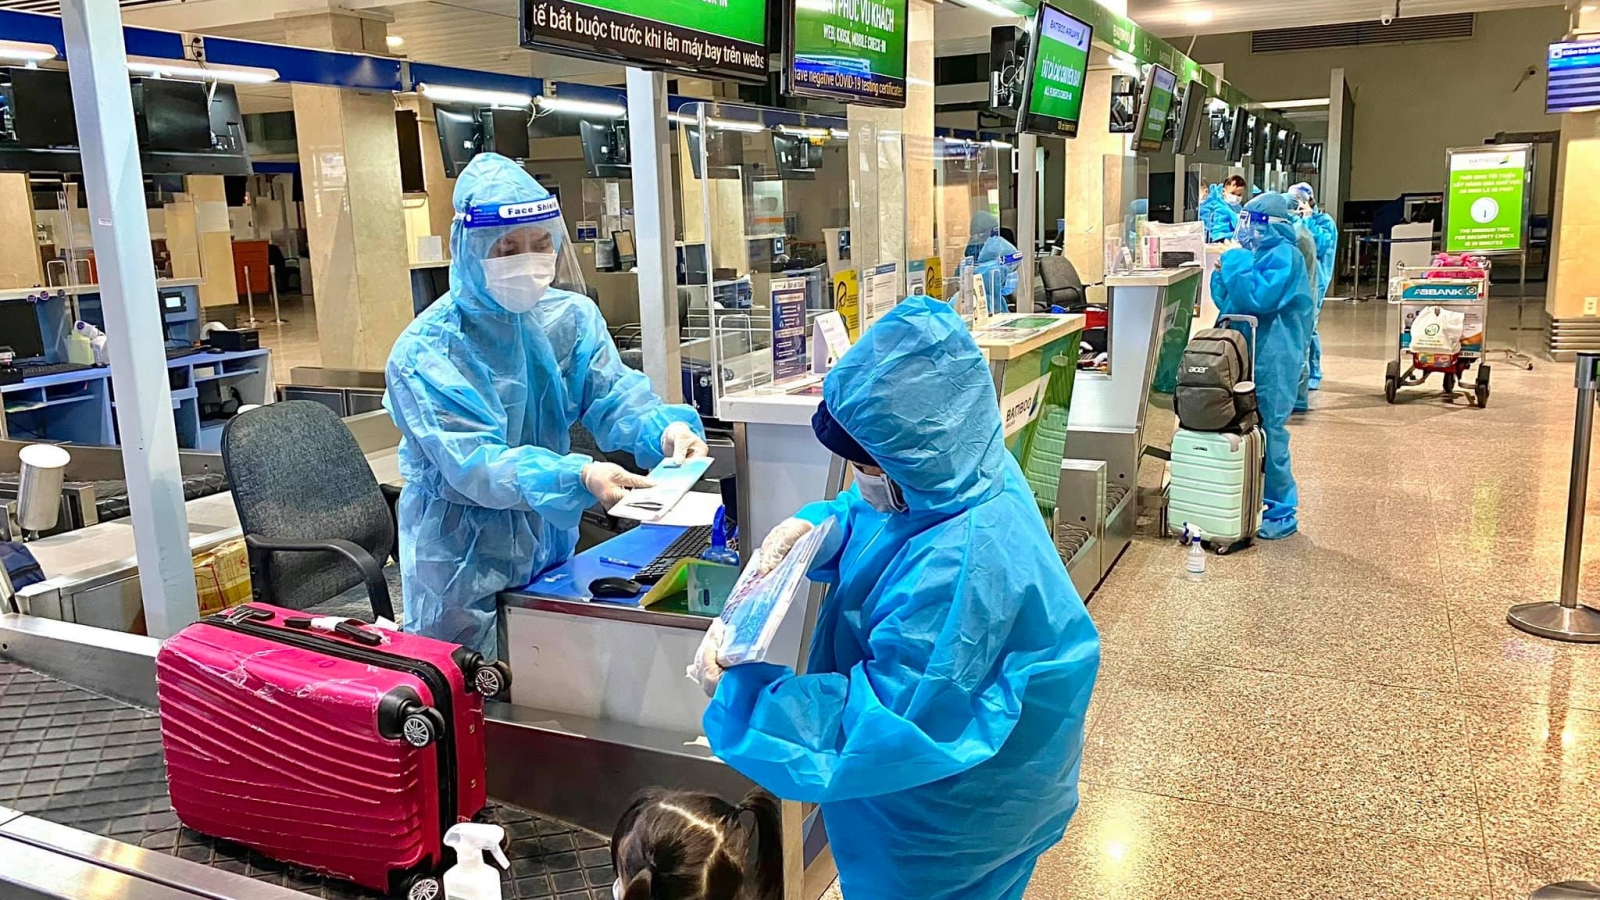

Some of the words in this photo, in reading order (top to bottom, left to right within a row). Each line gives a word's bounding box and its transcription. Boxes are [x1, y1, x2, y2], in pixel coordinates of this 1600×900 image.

[860, 0, 871, 32] VỤ
[871, 0, 894, 33] KHÁCH
[533, 2, 547, 27] tế
[549, 6, 572, 32] bắt
[575, 11, 608, 41] buộc
[610, 20, 642, 45] trước
[644, 26, 661, 49] khi
[663, 30, 680, 53] lên
[682, 37, 704, 61] máy
[704, 39, 722, 65] bay
[723, 45, 741, 65] trên
[823, 23, 836, 44] WEB,
[836, 27, 851, 48] KIOSK,
[851, 31, 868, 49] MOBILE
[808, 70, 835, 88] negative
[834, 72, 861, 91] COVID-19
[861, 78, 879, 97] testing
[507, 207, 534, 216] Face
[537, 201, 557, 212] Shield
[1188, 366, 1209, 374] acer
[1006, 397, 1032, 423] BAMBOO
